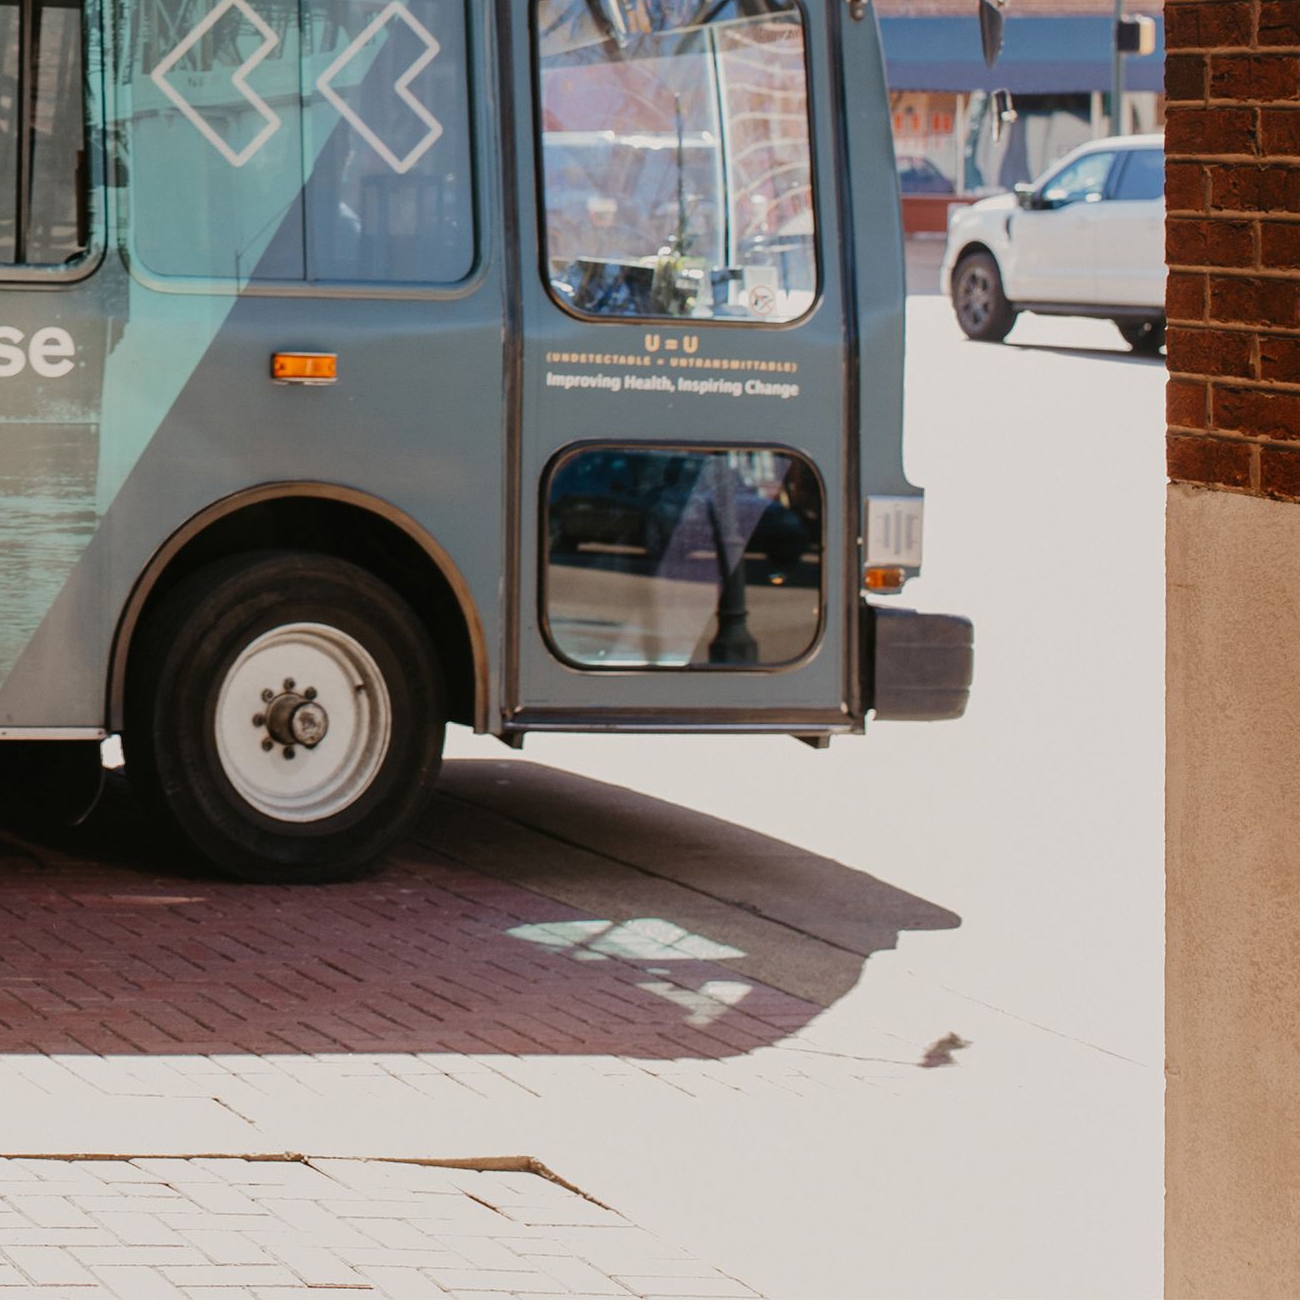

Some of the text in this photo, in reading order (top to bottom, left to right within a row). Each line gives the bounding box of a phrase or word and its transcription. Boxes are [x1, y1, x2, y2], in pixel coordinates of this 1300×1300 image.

[645, 334, 660, 353] U
[683, 335, 699, 354] U
[546, 372, 800, 399] Improving Health, Inspiring Change
